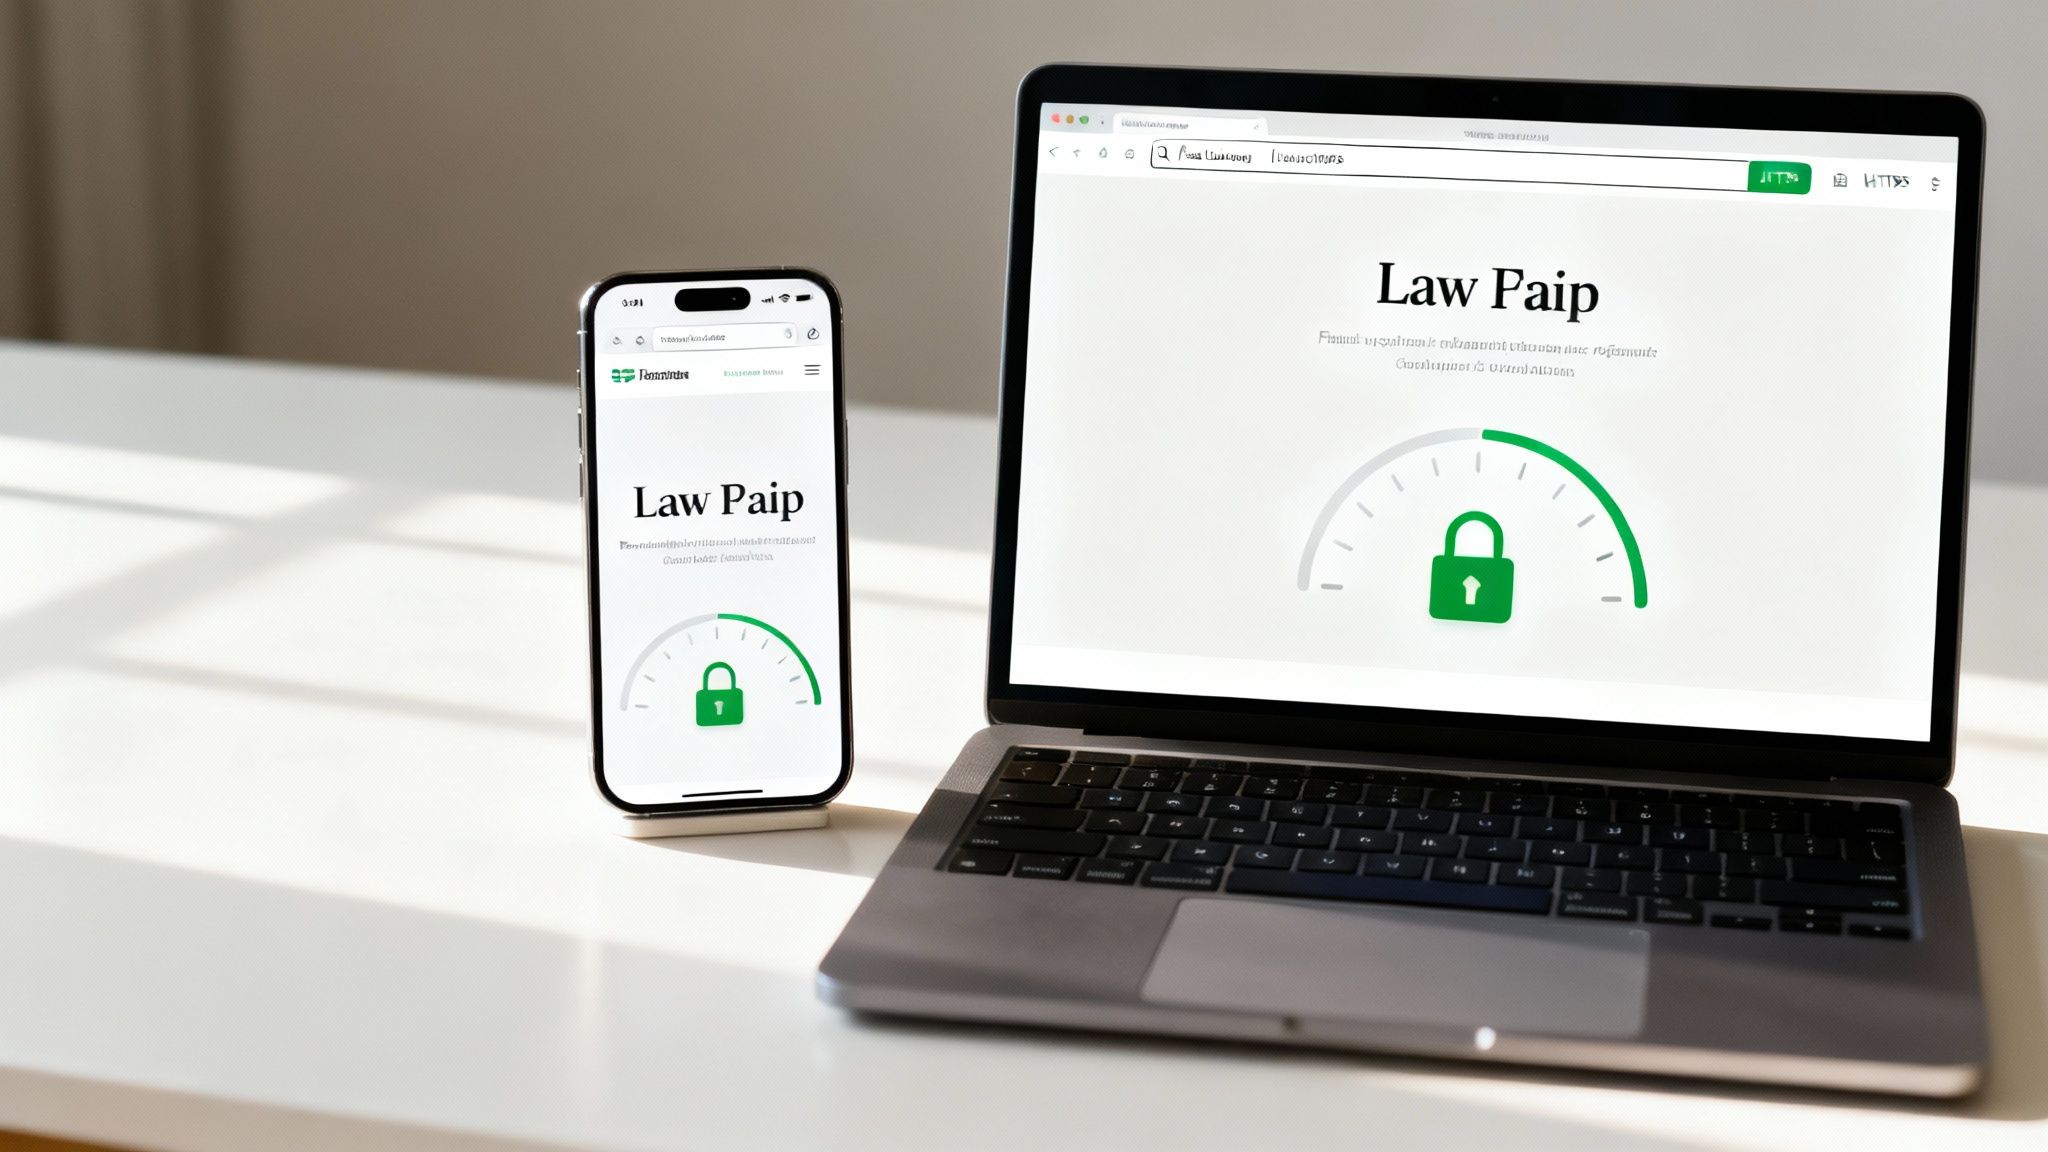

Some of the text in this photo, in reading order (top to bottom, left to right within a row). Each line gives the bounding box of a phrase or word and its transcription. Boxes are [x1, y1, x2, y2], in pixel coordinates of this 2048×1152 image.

[1376, 261, 1600, 323] Law Paip
[633, 481, 804, 522] Law Paip
